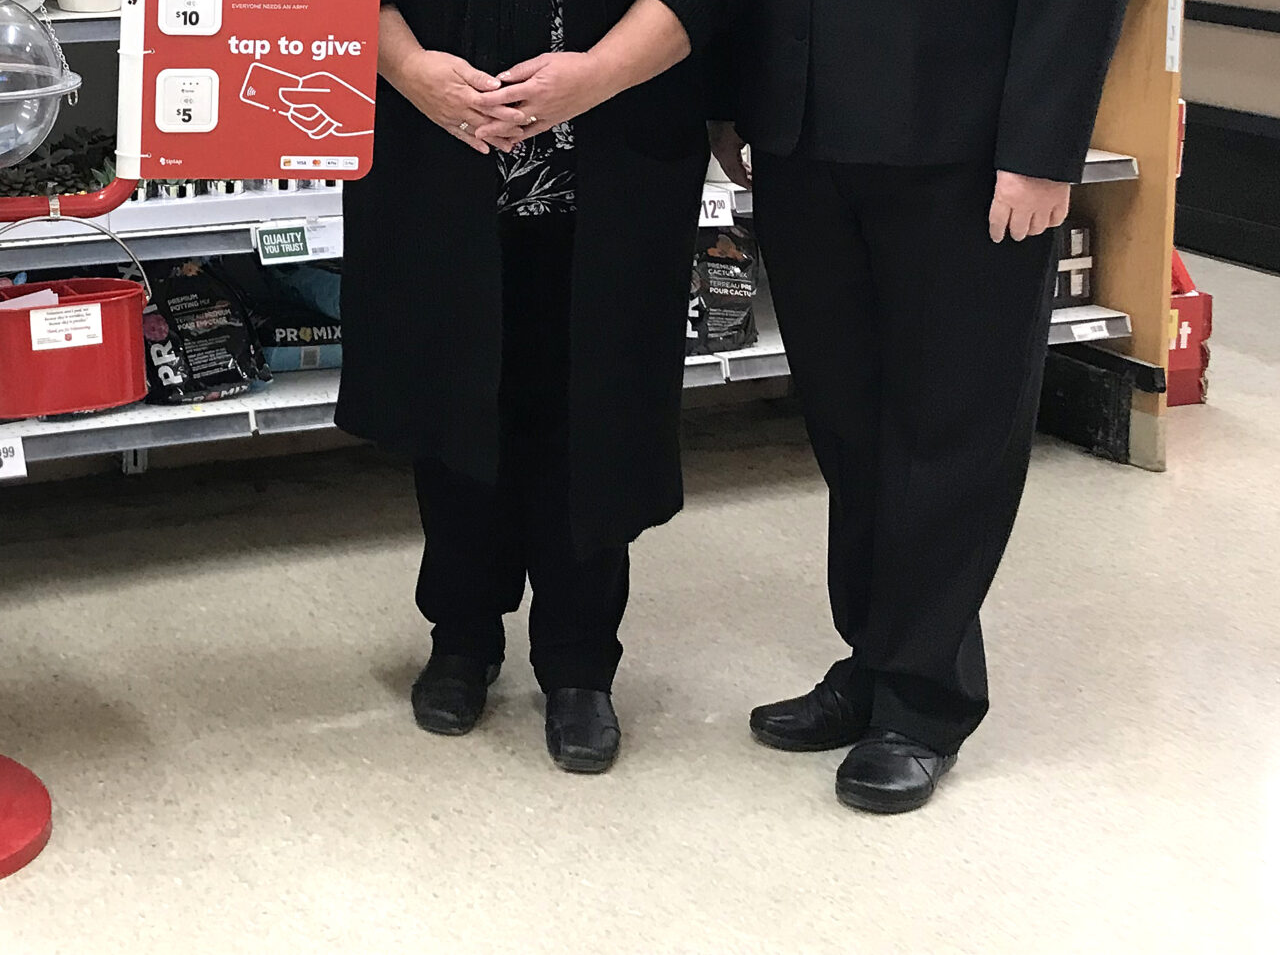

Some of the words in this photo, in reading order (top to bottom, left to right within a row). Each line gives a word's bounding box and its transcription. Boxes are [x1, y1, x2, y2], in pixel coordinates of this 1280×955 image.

[176, 10, 200, 26] $10
[228, 35, 271, 60] tap
[278, 36, 304, 56] to
[311, 34, 361, 61] give
[176, 108, 192, 123] $5
[263, 232, 302, 246] QUALITY
[264, 245, 280, 254] YOU
[281, 243, 304, 252] TRUST
[710, 287, 728, 295] POUR
